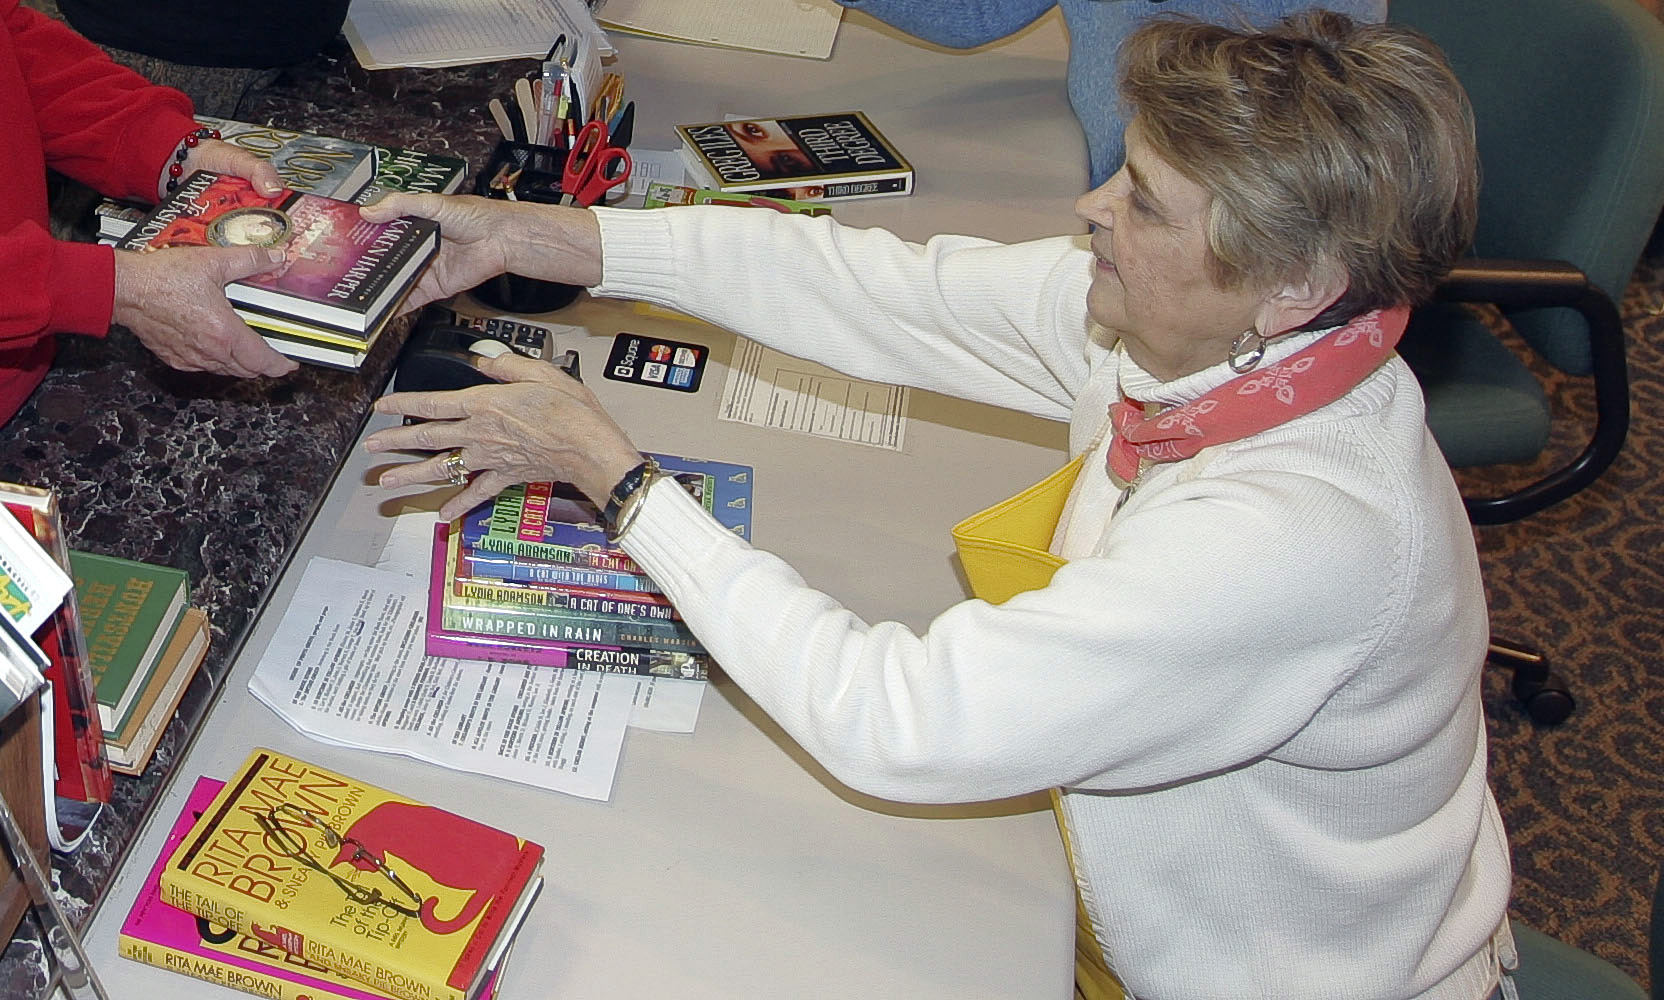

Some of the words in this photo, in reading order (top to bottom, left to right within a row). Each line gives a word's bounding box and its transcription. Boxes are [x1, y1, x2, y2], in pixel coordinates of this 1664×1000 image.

[798, 127, 851, 165] THIRD
[824, 120, 886, 166] DEGREE
[706, 149, 761, 183] GREG
[827, 184, 850, 198] THIRD
[851, 182, 880, 196] DEGREE
[367, 218, 413, 257] KAREN
[327, 255, 380, 299] HARPER
[620, 338, 641, 367] Square
[481, 537, 514, 555] LYDIA
[517, 541, 573, 564] ADAMSON
[464, 584, 494, 600] LYDIA
[496, 587, 544, 605] ADAMSON
[569, 596, 578, 609] A
[580, 597, 598, 612] CAT
[601, 600, 615, 613] OF
[617, 602, 647, 617] ONE'S
[649, 605, 672, 620] OWN
[462, 615, 537, 637] WRAPPED
[542, 623, 559, 639] IN
[564, 625, 603, 643] RAIN
[576, 648, 640, 666] CREATION
[191, 829, 264, 888] RITA
[238, 757, 308, 816] MAE
[228, 770, 350, 904] BROWN
[275, 897, 290, 911] &
[329, 787, 366, 831] BROWN
[169, 884, 193, 904] THE
[194, 893, 221, 915] TAIL
[223, 905, 245, 923] OF
[329, 903, 357, 930] The
[164, 952, 191, 970] RITA
[193, 958, 226, 979] MAE
[227, 969, 284, 997] BROWN
[307, 938, 335, 961] RITA
[339, 951, 372, 974] MAE
[375, 965, 433, 997] BROWN
